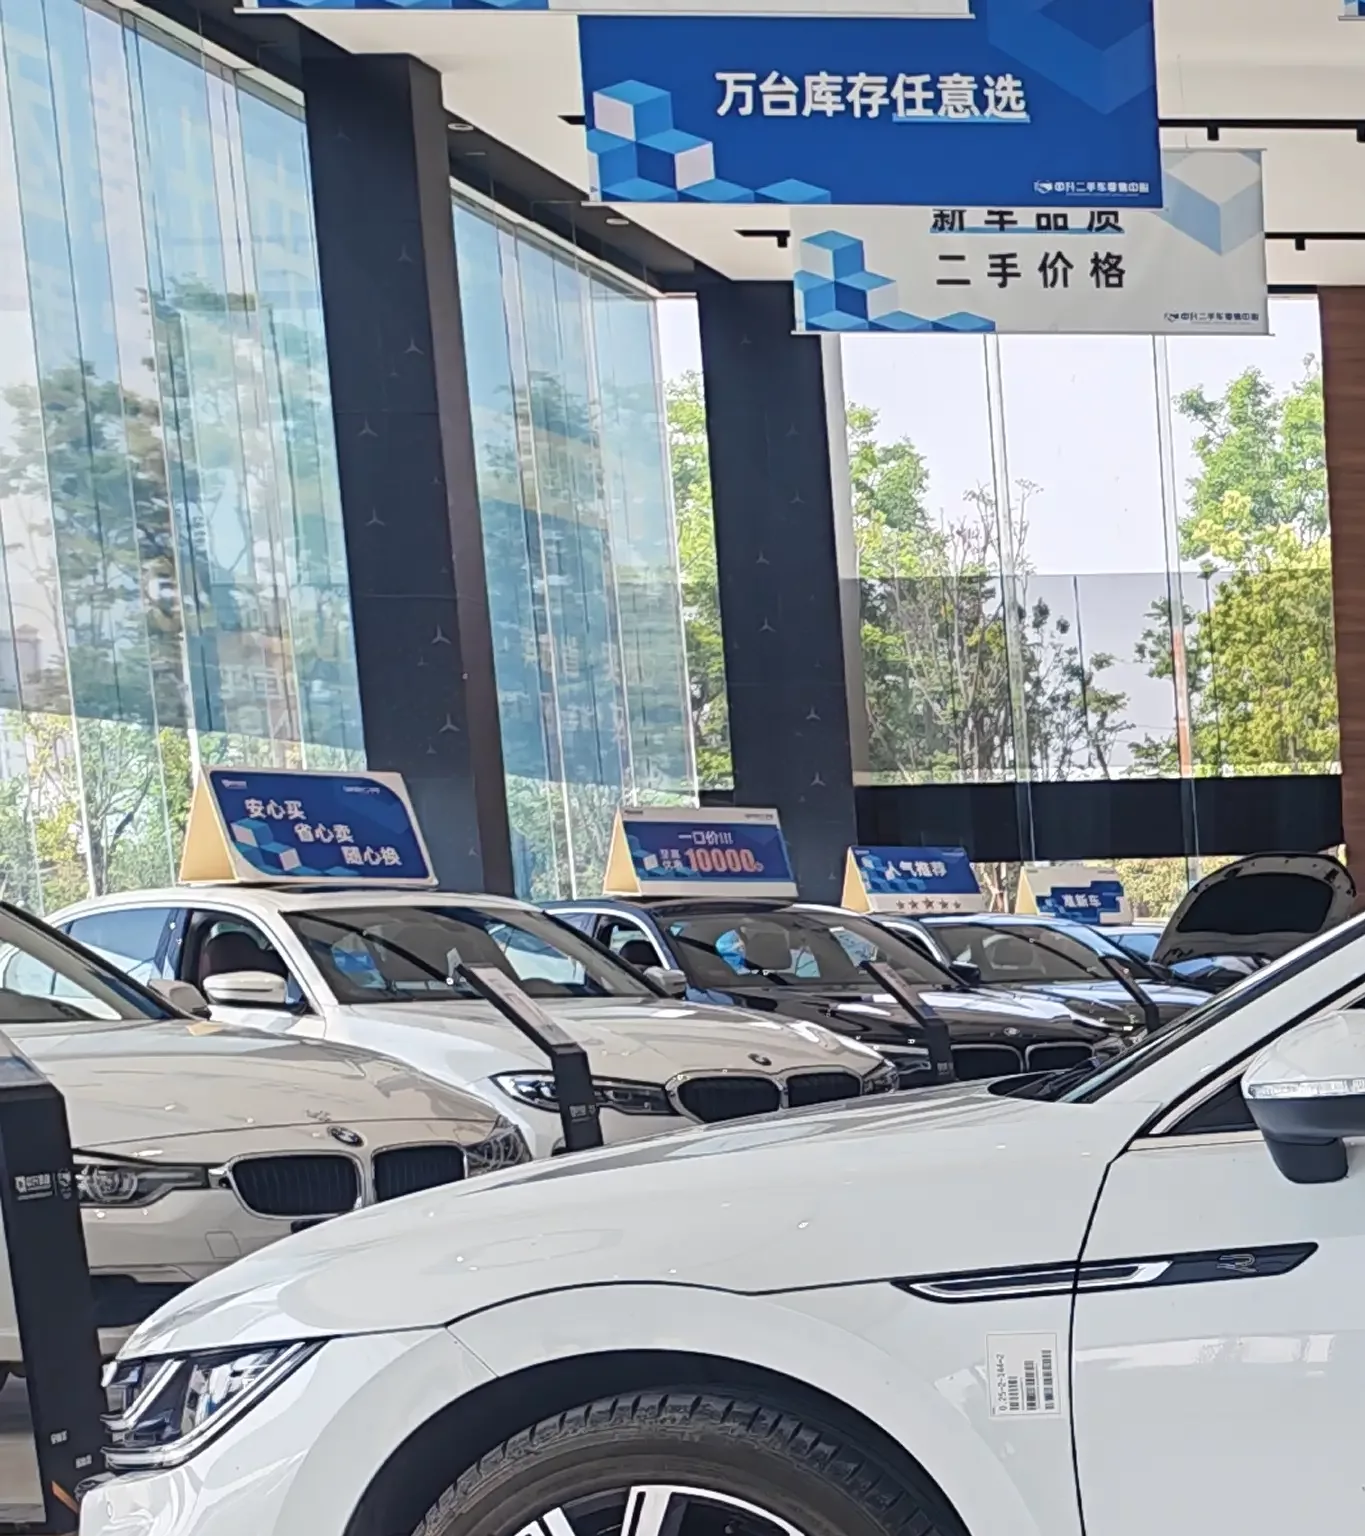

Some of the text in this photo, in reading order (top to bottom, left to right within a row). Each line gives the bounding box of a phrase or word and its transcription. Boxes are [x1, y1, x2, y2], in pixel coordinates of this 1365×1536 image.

[714, 70, 1028, 119] 万台库存任意选
[936, 251, 1126, 289] 二手价格
[244, 798, 307, 820] 安心买
[294, 823, 354, 843] 省心卖
